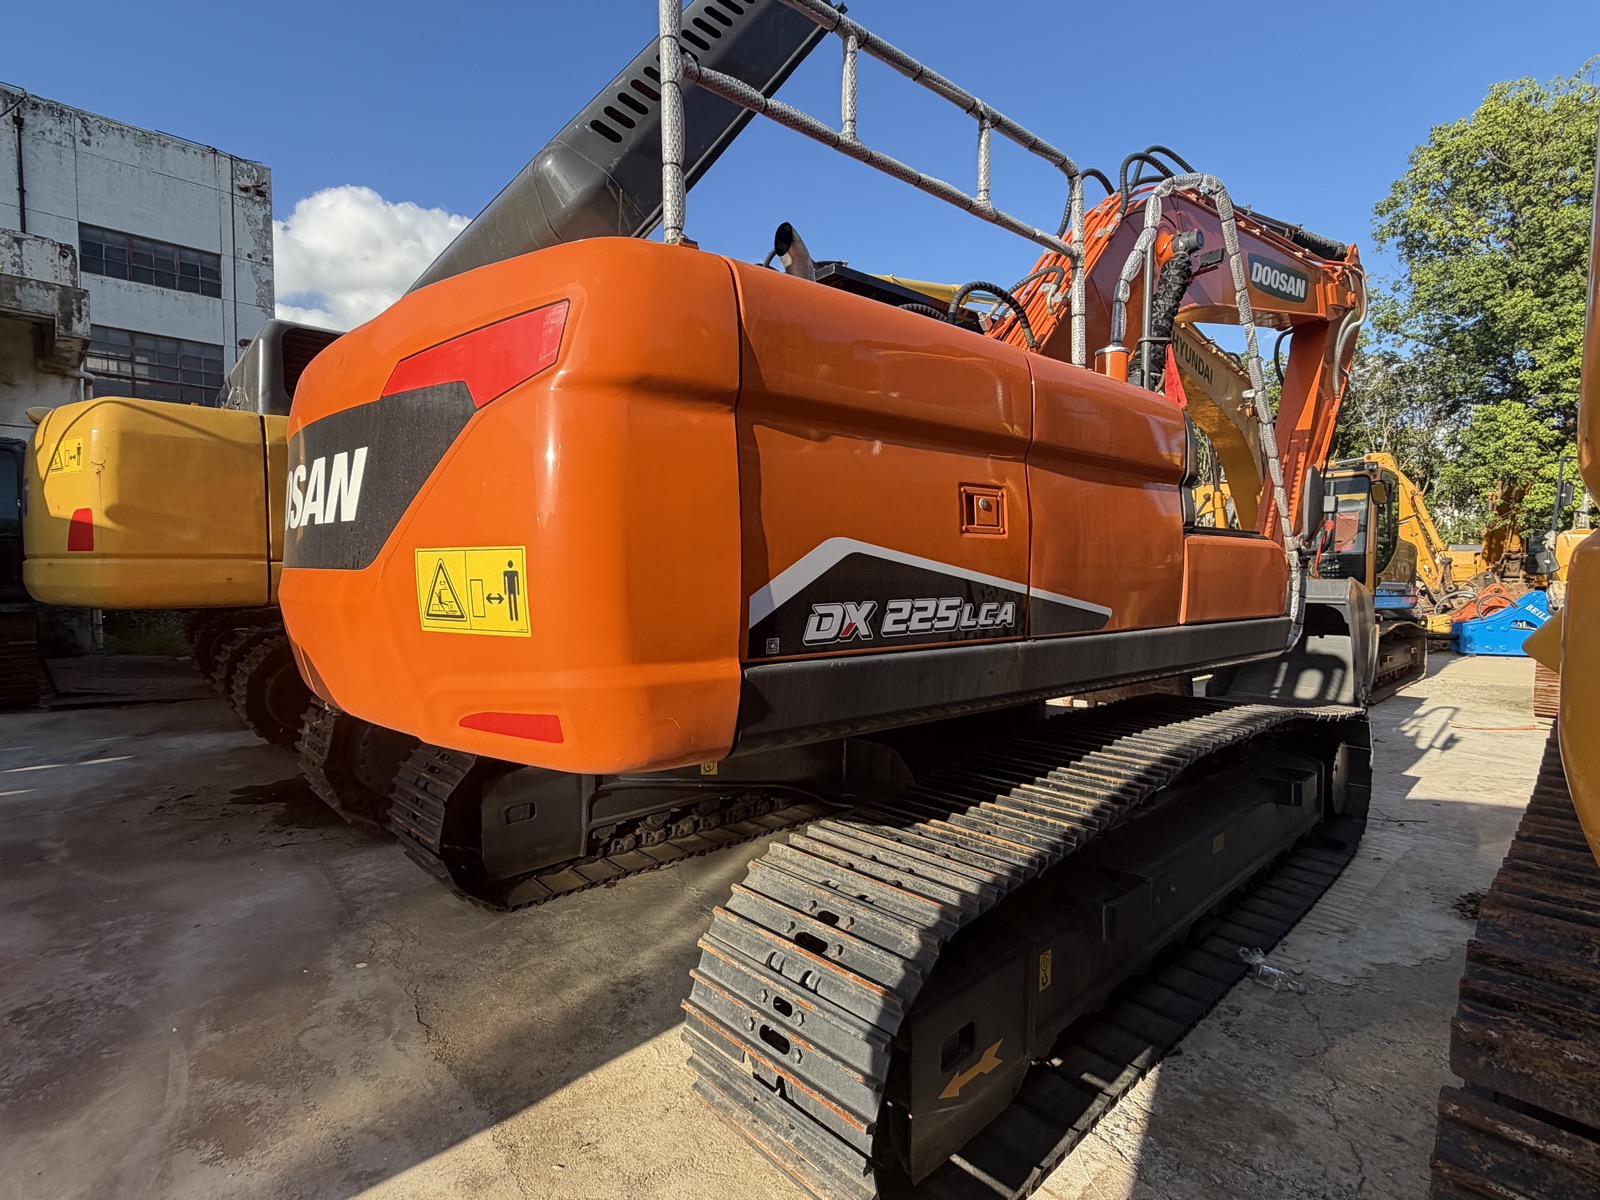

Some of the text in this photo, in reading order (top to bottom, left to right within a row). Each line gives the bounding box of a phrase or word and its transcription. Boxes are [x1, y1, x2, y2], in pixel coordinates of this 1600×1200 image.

[1251, 261, 1306, 298] DOOSAN
[1172, 331, 1213, 385] HYUNDAI
[803, 600, 878, 646] DX
